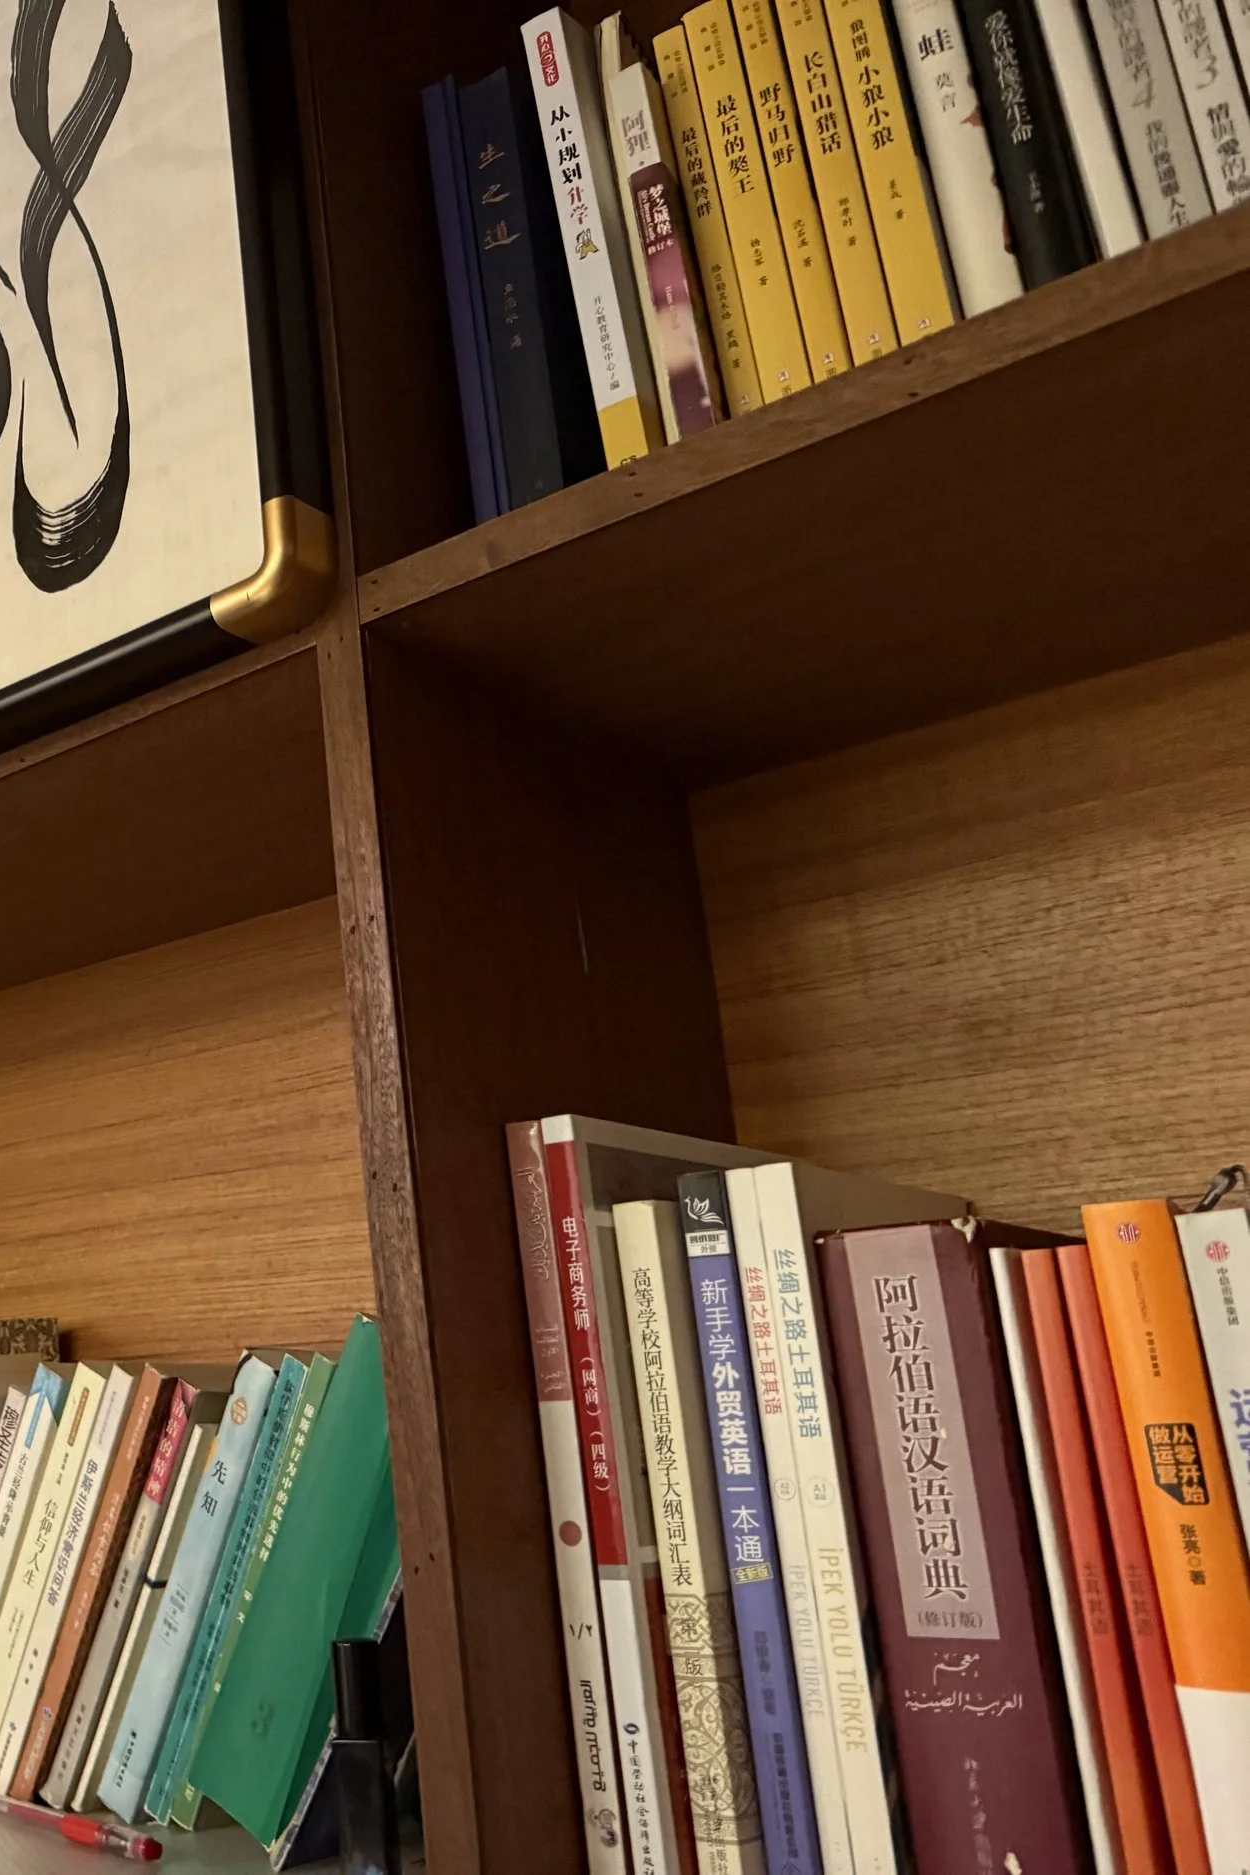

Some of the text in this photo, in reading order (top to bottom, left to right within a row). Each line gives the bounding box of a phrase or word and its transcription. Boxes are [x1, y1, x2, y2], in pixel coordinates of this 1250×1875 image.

[848, 18, 895, 150] 狼图腾 小狼小狼
[918, 27, 955, 61] 蛙
[621, 110, 651, 158] 阿狸
[759, 82, 796, 168] 野马归野
[803, 51, 842, 155] 长白山猎话
[935, 71, 960, 113] 莫言
[550, 105, 589, 225] 从小规划升学
[681, 126, 713, 219] 最后的藏羚群
[716, 94, 756, 197] 最后的獒王
[561, 1216, 592, 1332] 电子商务师
[1216, 1265, 1240, 1326] 中信出版集团
[744, 1267, 783, 1414] 丝绸之路土耳其语
[773, 1248, 823, 1439] 丝绸之路土耳其语
[631, 1267, 693, 1587] 高等学校阿拉伯语教学大纲词汇表
[700, 1278, 766, 1563] 新手学外贸英语一本通
[873, 1274, 969, 1599] 阿拉伯语汉语词典
[1172, 1425, 1205, 1504] 从零开始
[200, 1459, 228, 1518] 先知
[22, 1499, 62, 1590] 信仰与人生
[827, 1605, 853, 1658] YOLU
[836, 1668, 868, 1752] TÜRKÇE
